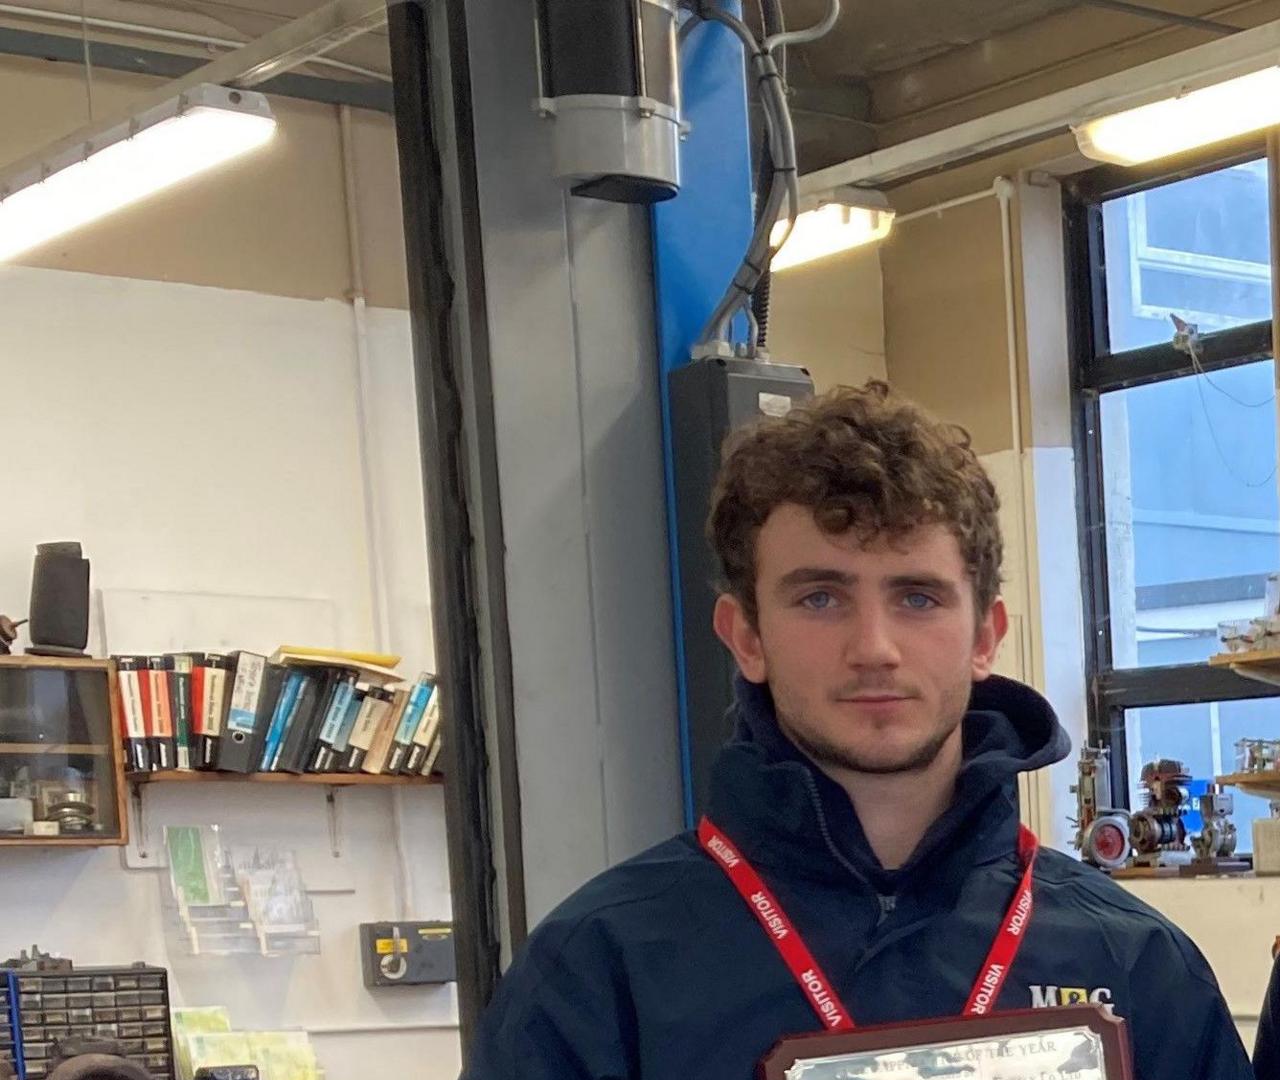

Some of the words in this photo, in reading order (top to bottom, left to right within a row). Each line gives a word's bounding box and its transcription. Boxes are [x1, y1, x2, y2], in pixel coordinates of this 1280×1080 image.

[707, 835, 740, 868] VISITOR
[750, 890, 790, 940] VISITOR
[1006, 890, 1033, 936] VISITOR
[800, 968, 844, 1028] VISITOR
[970, 963, 1005, 1015] VISITOR
[1019, 1041, 1057, 1056] YEAR
